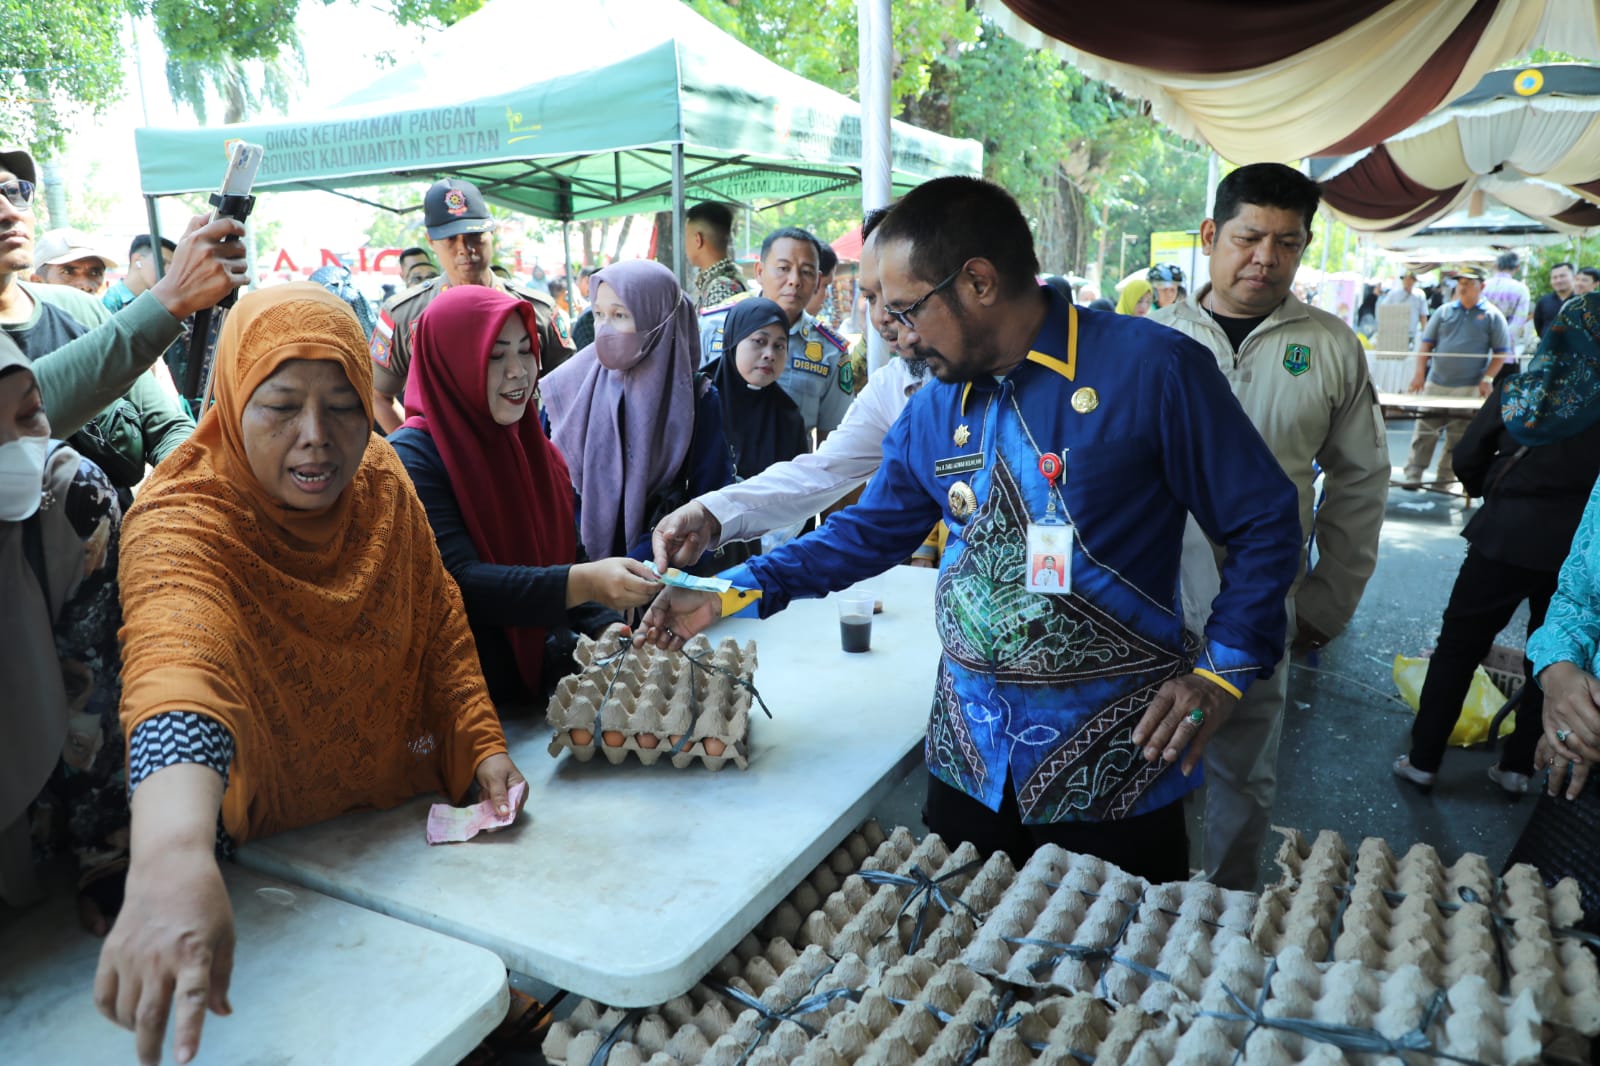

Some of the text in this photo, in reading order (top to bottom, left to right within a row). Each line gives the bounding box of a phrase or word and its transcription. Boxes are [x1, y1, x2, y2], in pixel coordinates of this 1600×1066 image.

[265, 106, 477, 151] DINAS KETAHANAN PANGAN
[261, 129, 500, 176] ROVINSI KALIMANTAN SELATAN
